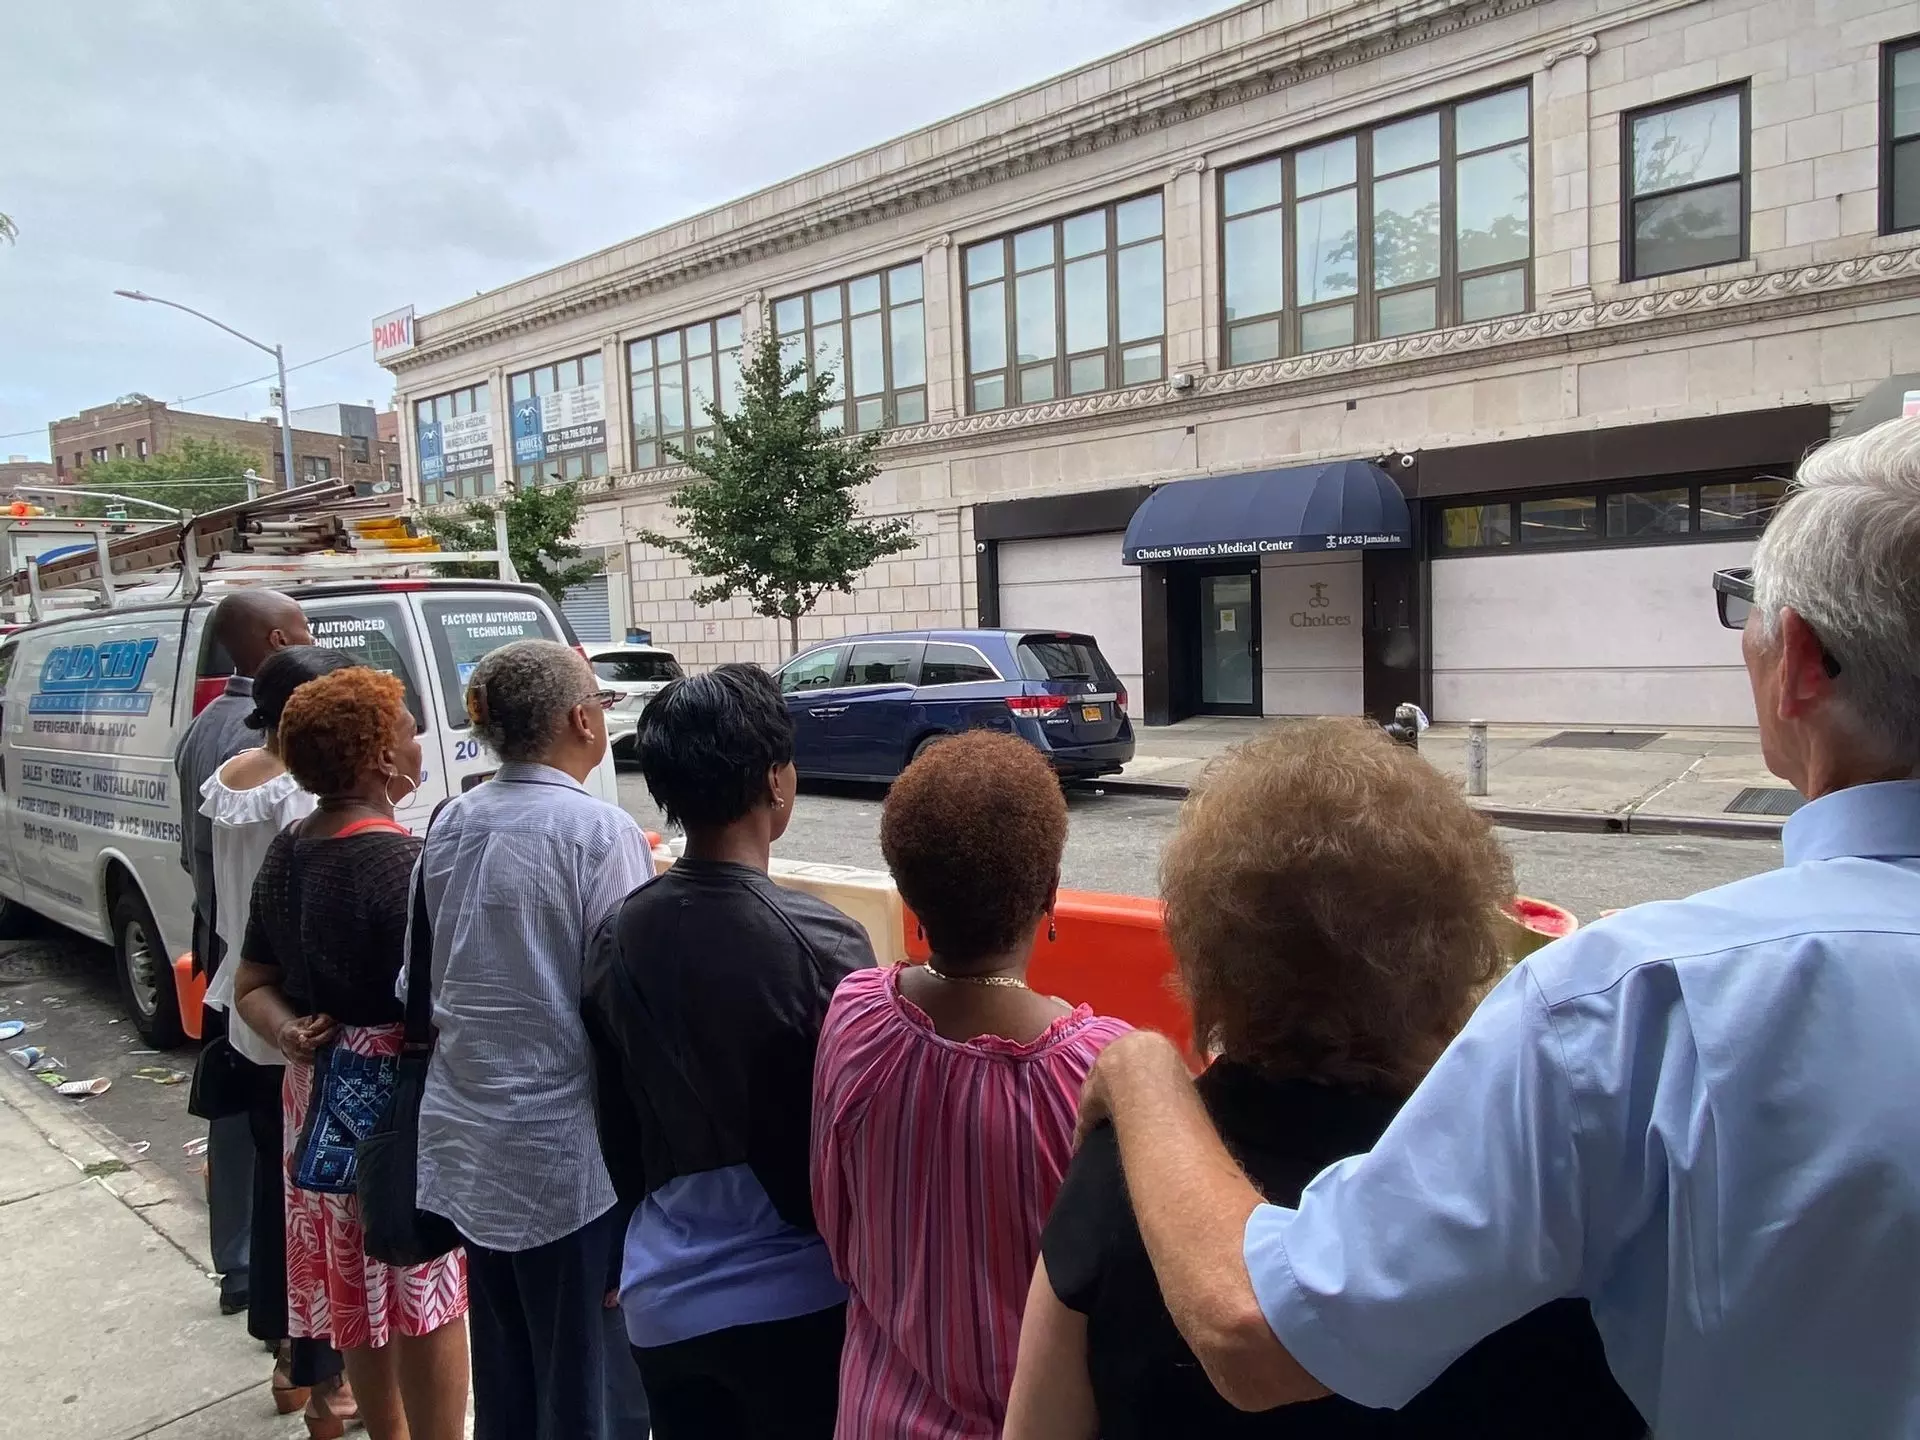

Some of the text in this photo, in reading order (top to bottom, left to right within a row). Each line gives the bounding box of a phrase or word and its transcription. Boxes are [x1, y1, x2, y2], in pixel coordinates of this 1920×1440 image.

[1338, 535, 1363, 545] 147-32
[1363, 534, 1389, 545] Jamaica
[1136, 549, 1171, 560] Choices
[1173, 545, 1216, 557] Women's
[1217, 541, 1256, 554] Medical
[1258, 540, 1293, 551] Center
[441, 611, 538, 625] FACTORY AUTHORIZED
[1289, 612, 1351, 628] Choices
[318, 619, 385, 634] AUTHORIZED
[466, 625, 524, 638] TECHNICIANS
[33, 720, 137, 737] REFRIGERATION & HVAC
[22, 764, 165, 801] SALES SERVICE INSTALLATION
[125, 816, 139, 835] ICE
[142, 818, 181, 842] MAKERS
